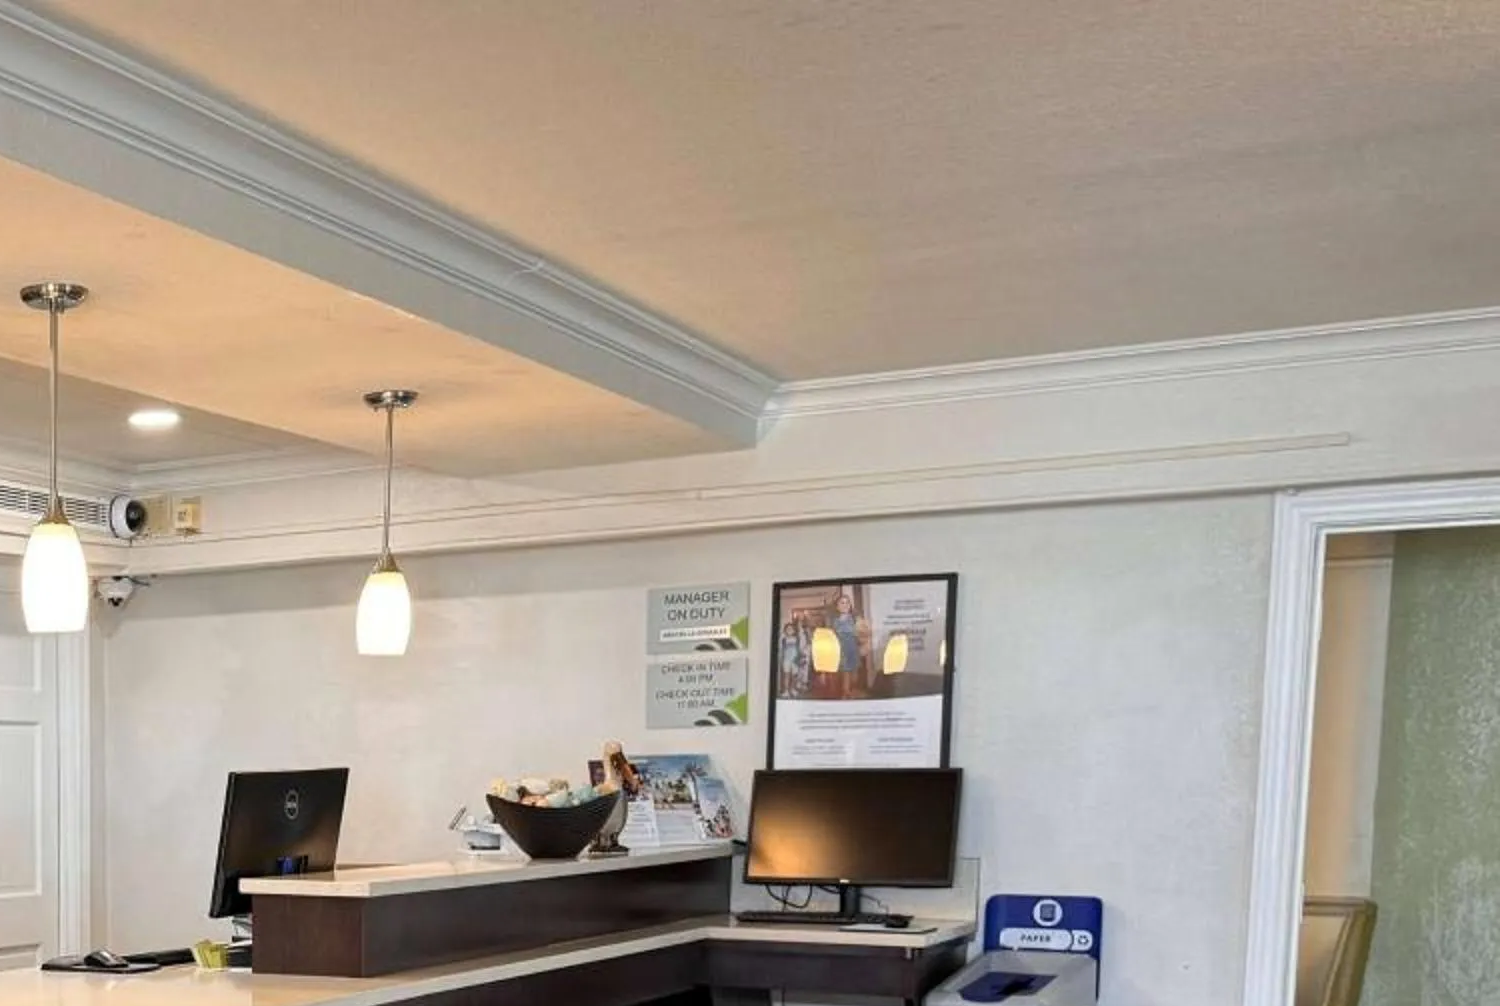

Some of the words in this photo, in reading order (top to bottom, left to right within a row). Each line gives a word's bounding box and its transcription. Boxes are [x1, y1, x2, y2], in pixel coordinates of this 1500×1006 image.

[663, 591, 729, 605] MANAGER
[667, 608, 687, 621] ON
[689, 606, 726, 619] DUTY
[661, 663, 694, 674] CHECK
[654, 688, 689, 700] CHECK
[1020, 933, 1051, 943] PAPER
